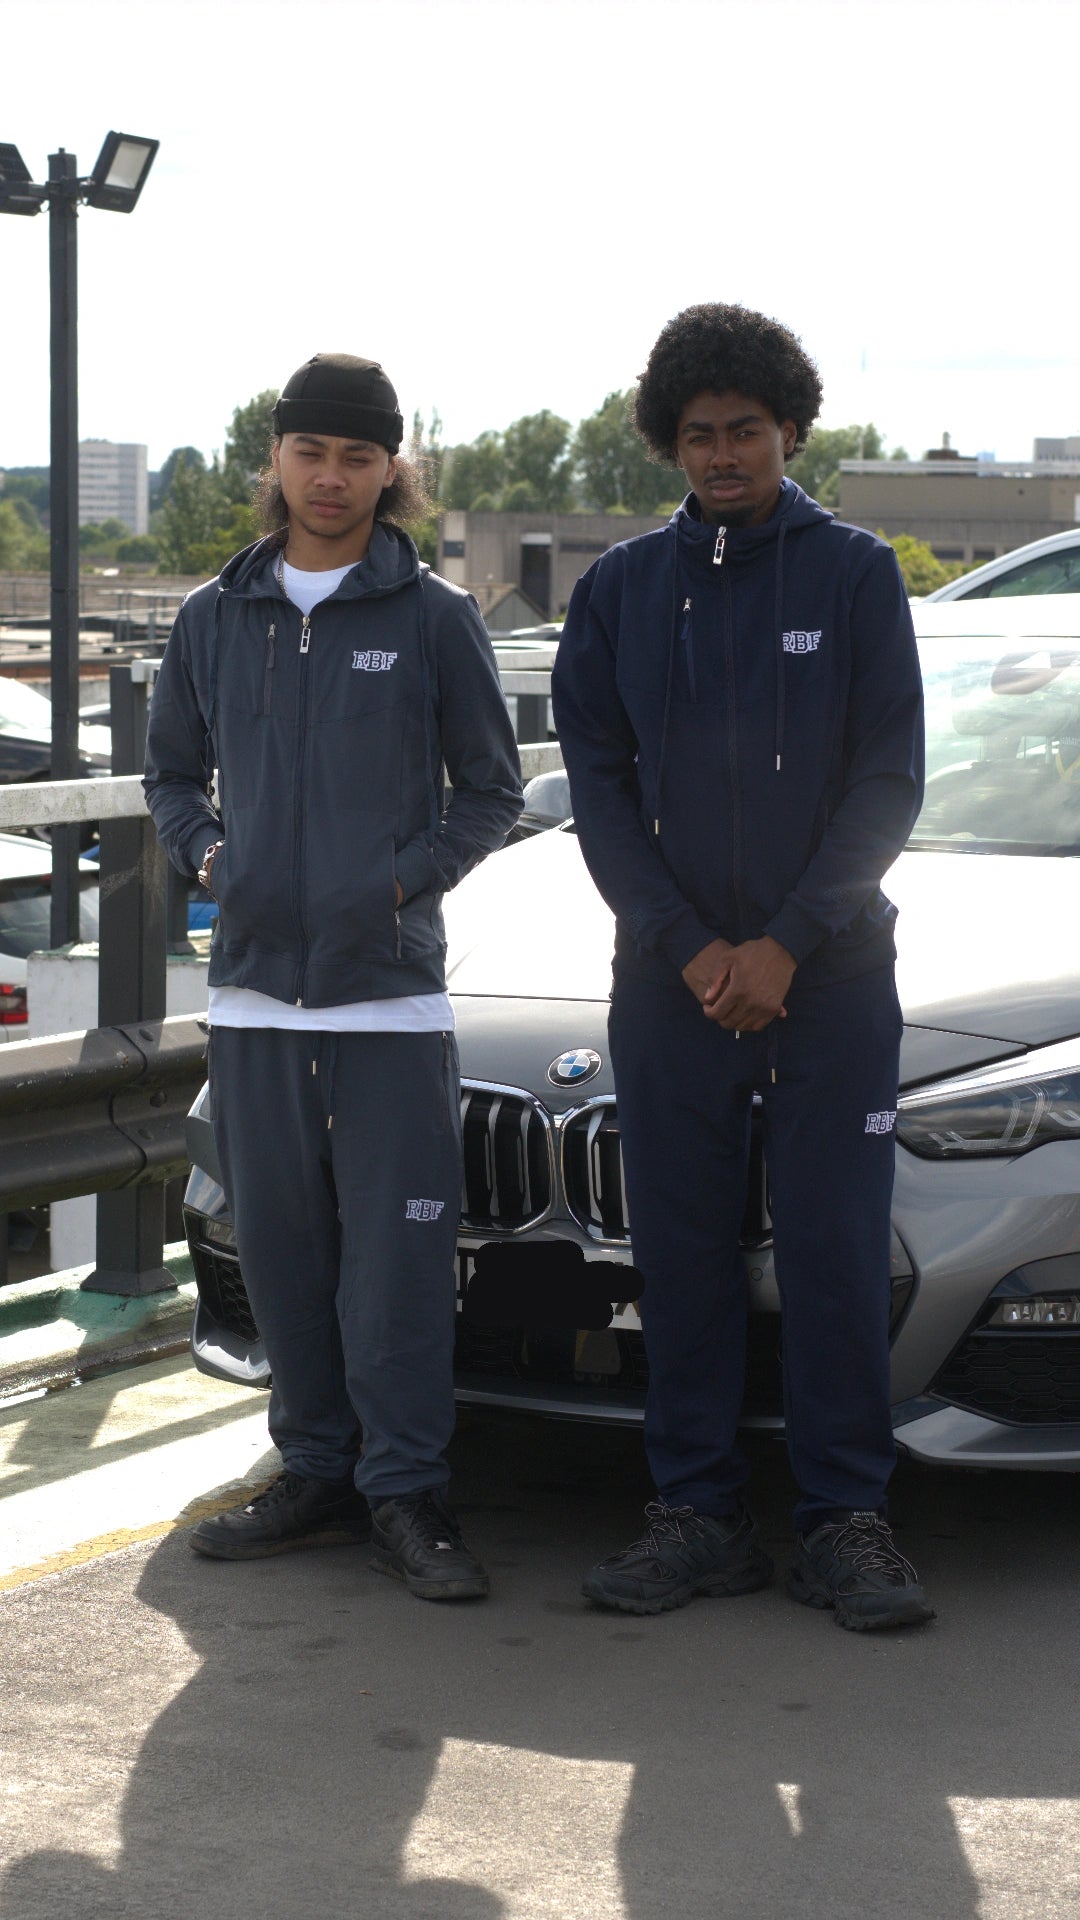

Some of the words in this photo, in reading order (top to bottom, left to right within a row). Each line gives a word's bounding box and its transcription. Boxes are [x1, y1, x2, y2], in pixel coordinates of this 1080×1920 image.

[782, 630, 821, 653] RBF
[352, 650, 397, 671] RBF
[865, 1111, 897, 1134] RBF
[406, 1199, 444, 1221] RBF
